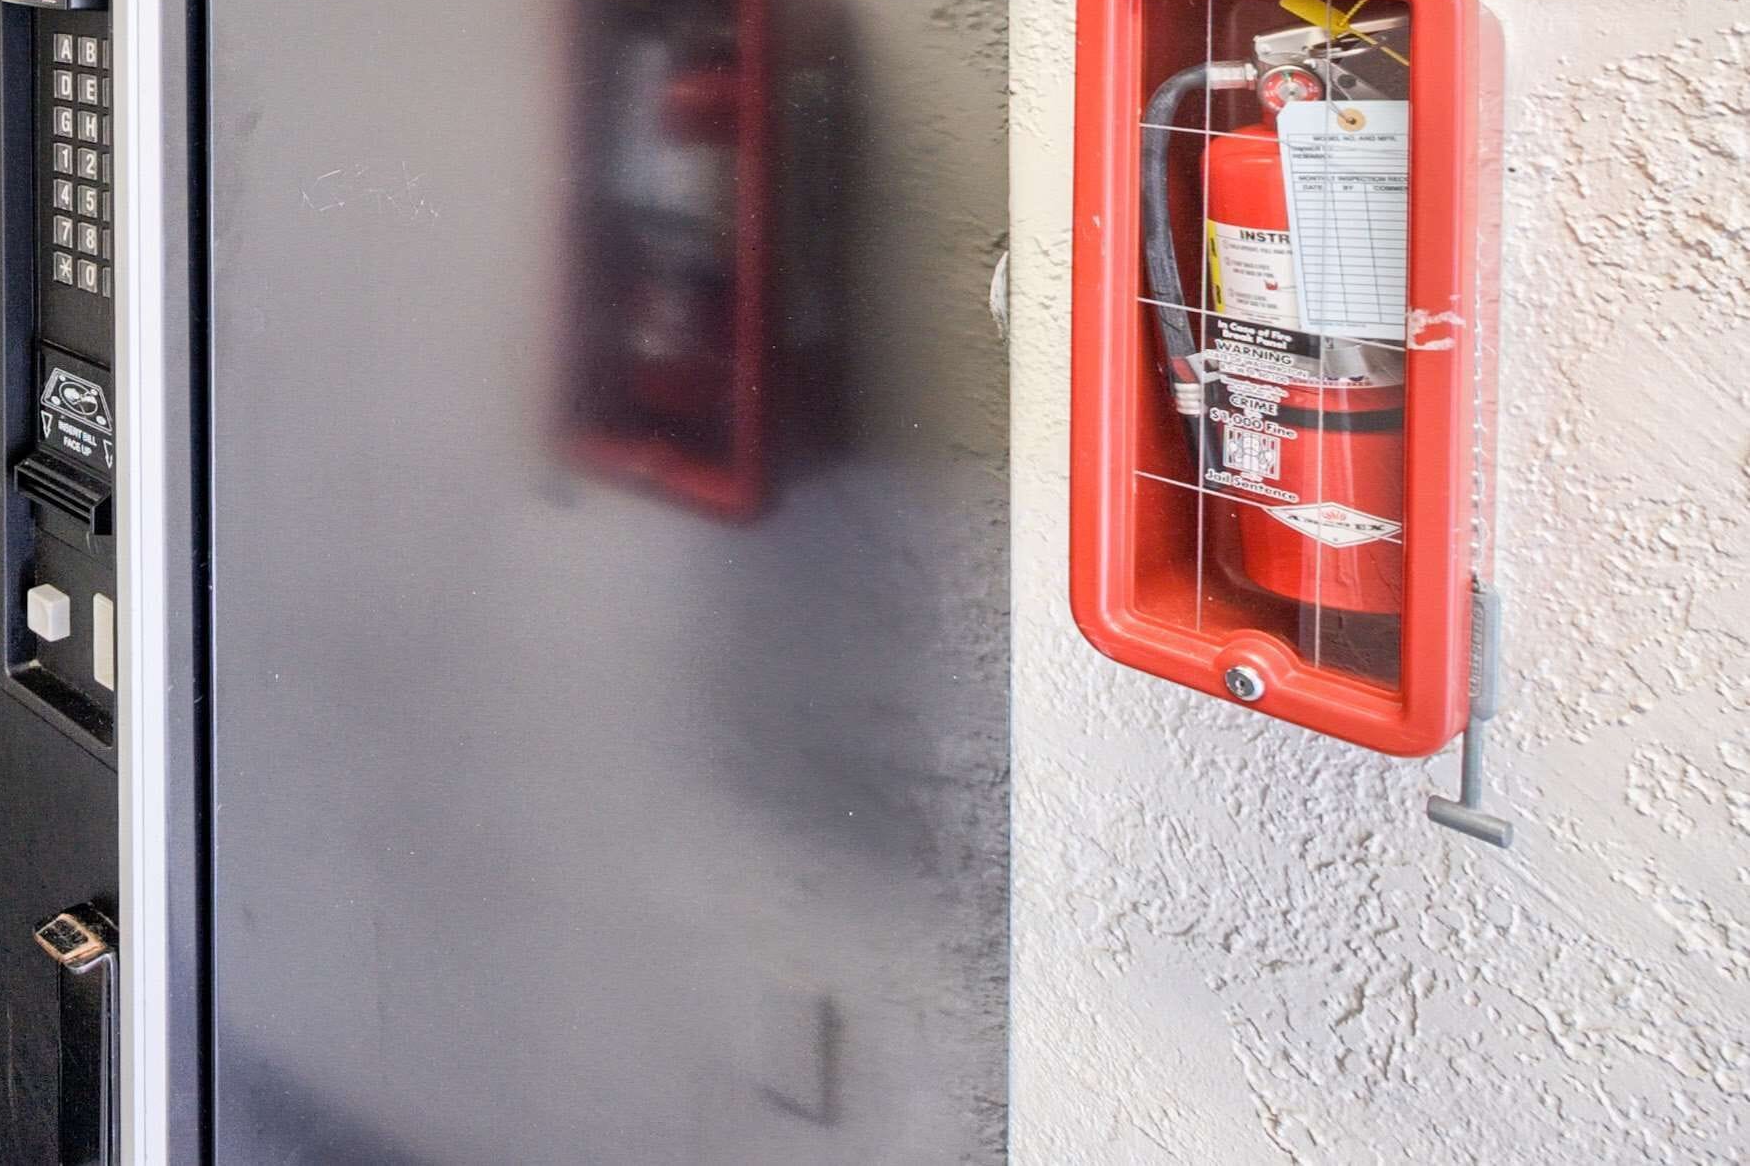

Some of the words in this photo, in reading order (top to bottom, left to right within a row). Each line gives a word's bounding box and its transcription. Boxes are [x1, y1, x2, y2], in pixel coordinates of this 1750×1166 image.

[61, 38, 71, 60] A
[85, 41, 96, 63] B
[61, 74, 70, 96] D
[86, 78, 96, 101] E
[61, 111, 71, 133] G
[86, 114, 96, 137] H
[62, 148, 70, 169] 1
[86, 152, 95, 175] 2
[61, 184, 70, 206] 4
[86, 190, 95, 213] 5
[61, 221, 71, 242] 7
[86, 228, 96, 250] 8
[86, 264, 96, 287] 0
[1217, 319, 1228, 330] In
[1229, 321, 1256, 335] Case
[1257, 327, 1270, 338] of
[1270, 328, 1294, 343] Fire
[1222, 329, 1255, 343] Break
[1256, 336, 1288, 350] Panel
[1216, 339, 1293, 365] WARNING
[1230, 396, 1277, 415] CRIME
[57, 419, 82, 439] INSERT
[82, 431, 98, 446] BILL
[1265, 422, 1297, 439] Fine
[63, 435, 81, 452] FACE
[81, 443, 92, 456] UP
[1206, 468, 1233, 483] Jail
[1233, 474, 1298, 502] Sentence
